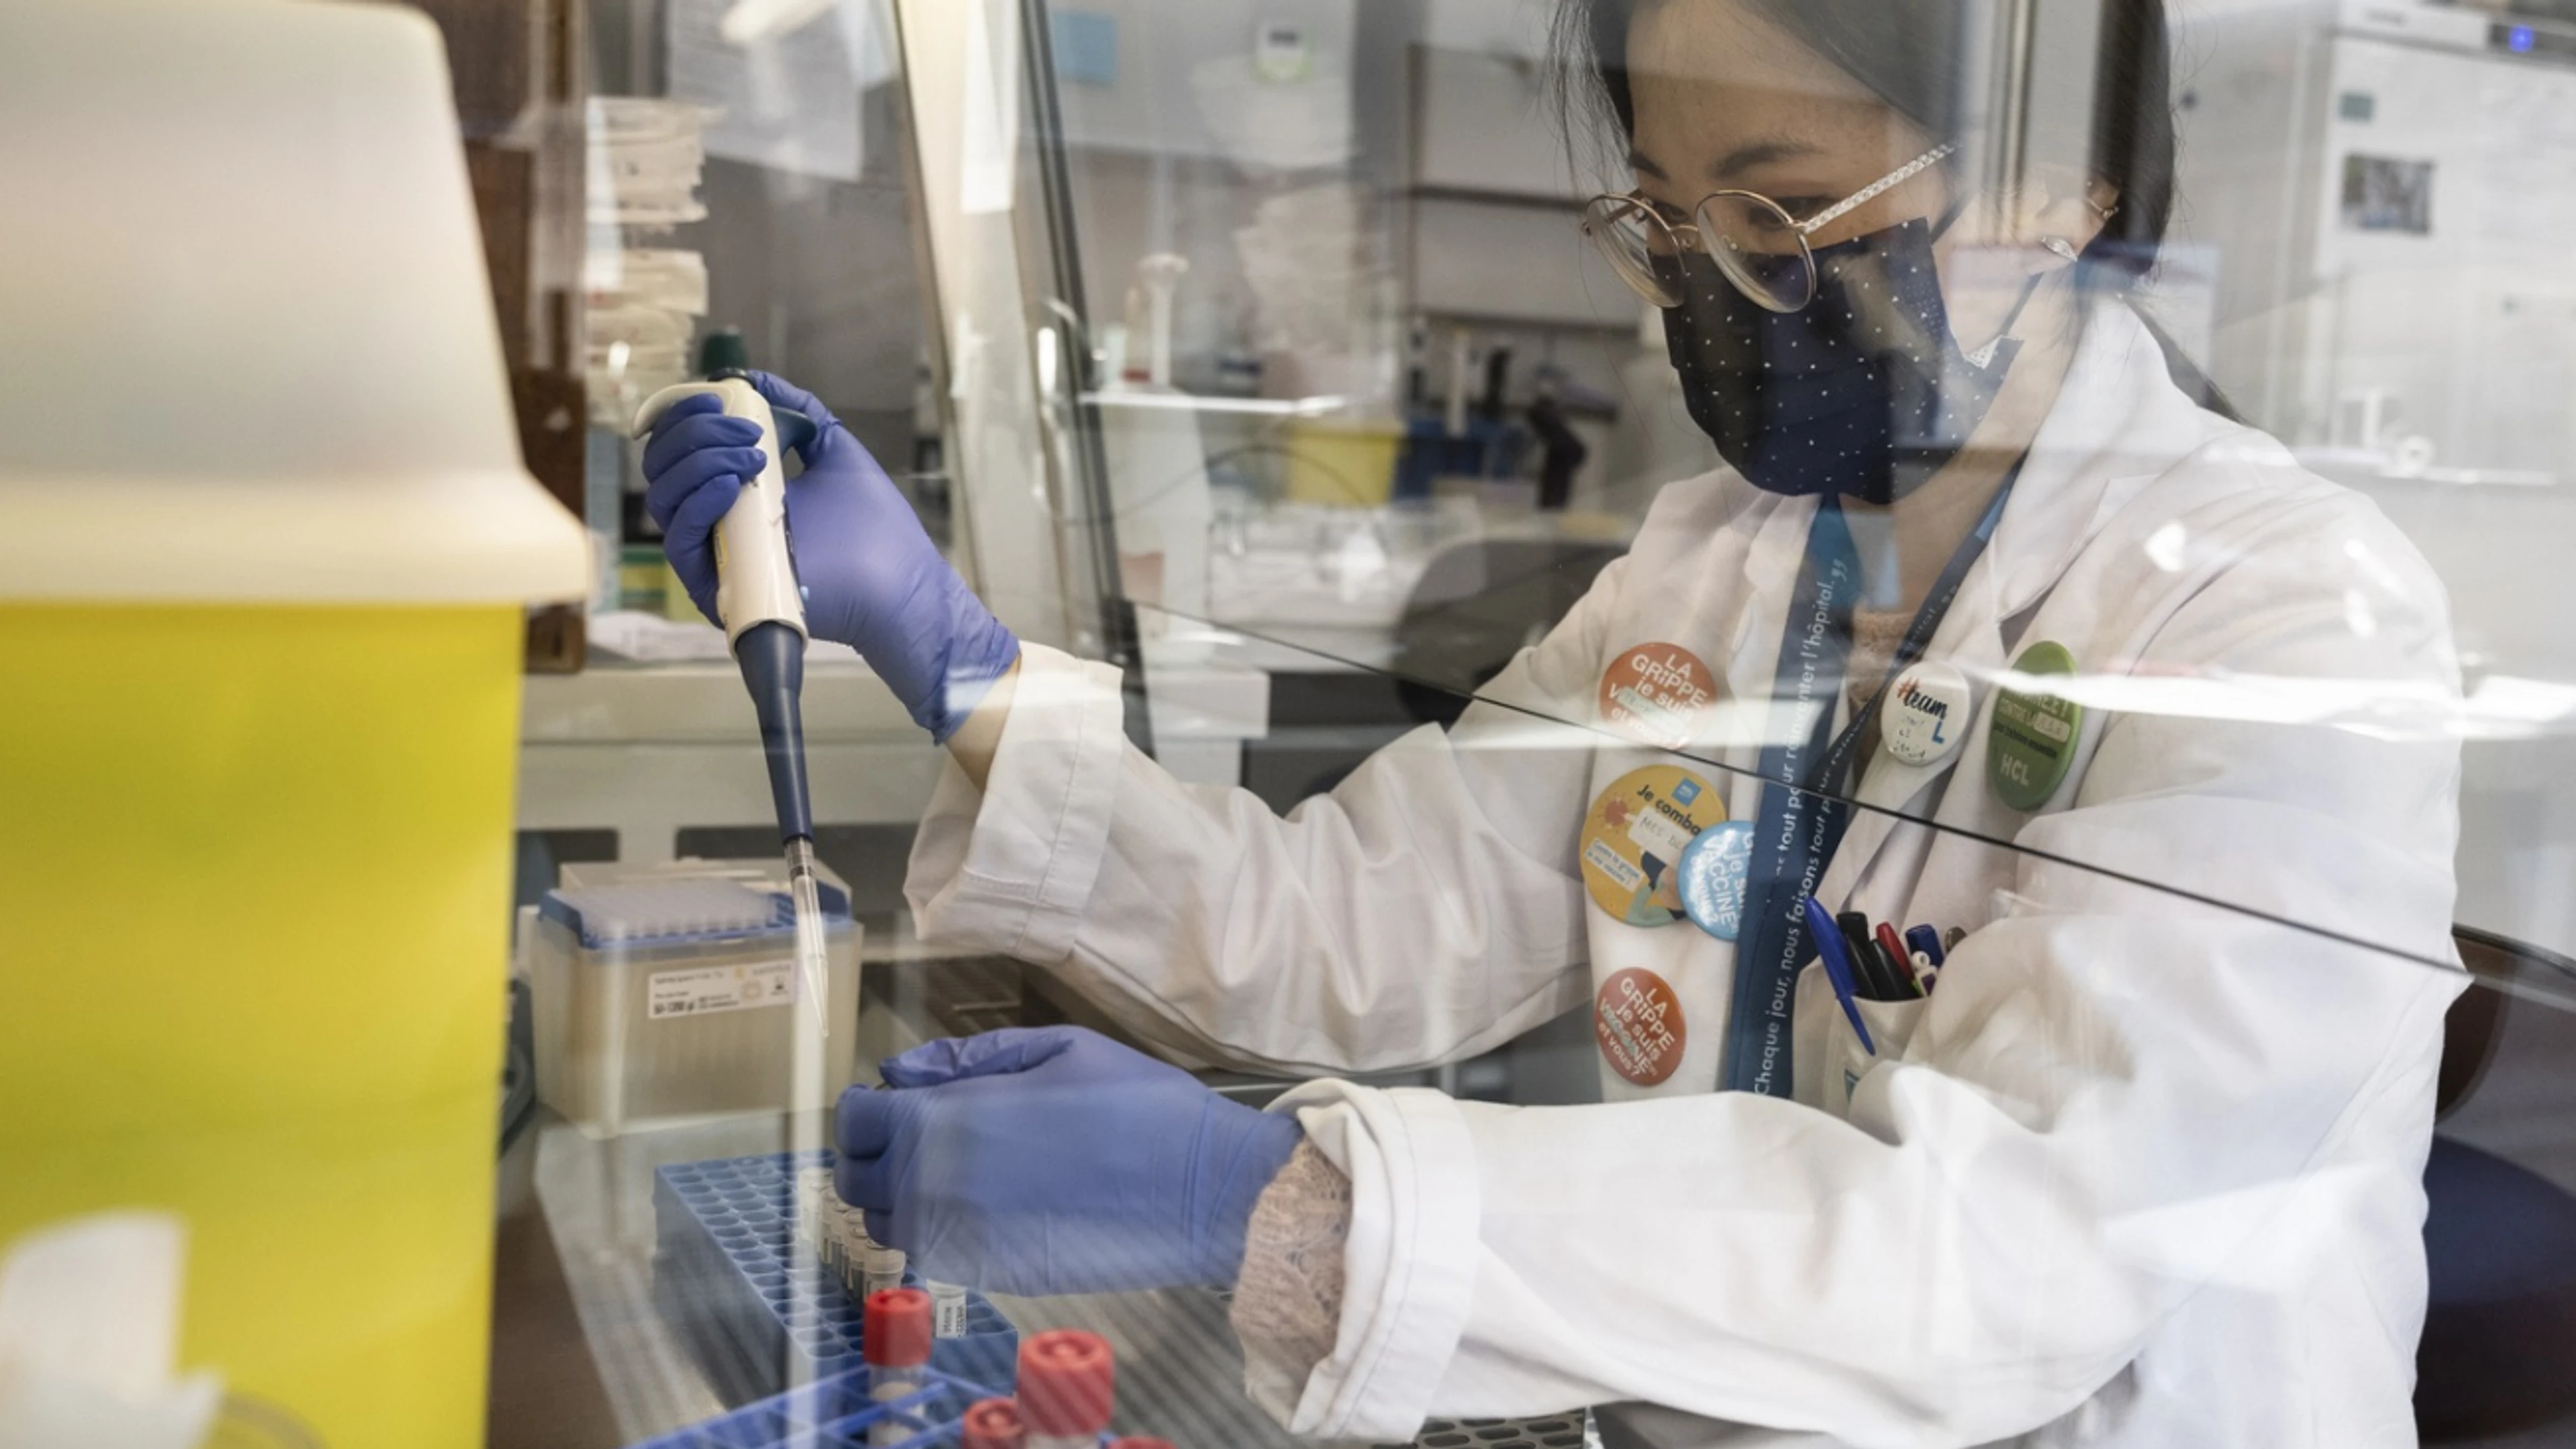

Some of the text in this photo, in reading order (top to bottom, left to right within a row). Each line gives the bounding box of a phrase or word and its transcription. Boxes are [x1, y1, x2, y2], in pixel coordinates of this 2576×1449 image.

[1666, 653, 1691, 678] LA
[1635, 676, 1654, 696] je
[1999, 753, 2030, 786] HCL
[1637, 784, 1654, 802] Je
[1777, 812, 1796, 852] tout
[1811, 816, 1826, 852] tout
[1786, 855, 1819, 924] faisons
[1781, 928, 1801, 970] nous
[1646, 987, 1667, 1019] LA
[1765, 978, 1793, 1018] jour,
[1598, 1022, 1610, 1038] et
[1755, 1021, 1780, 1095] Chaque
